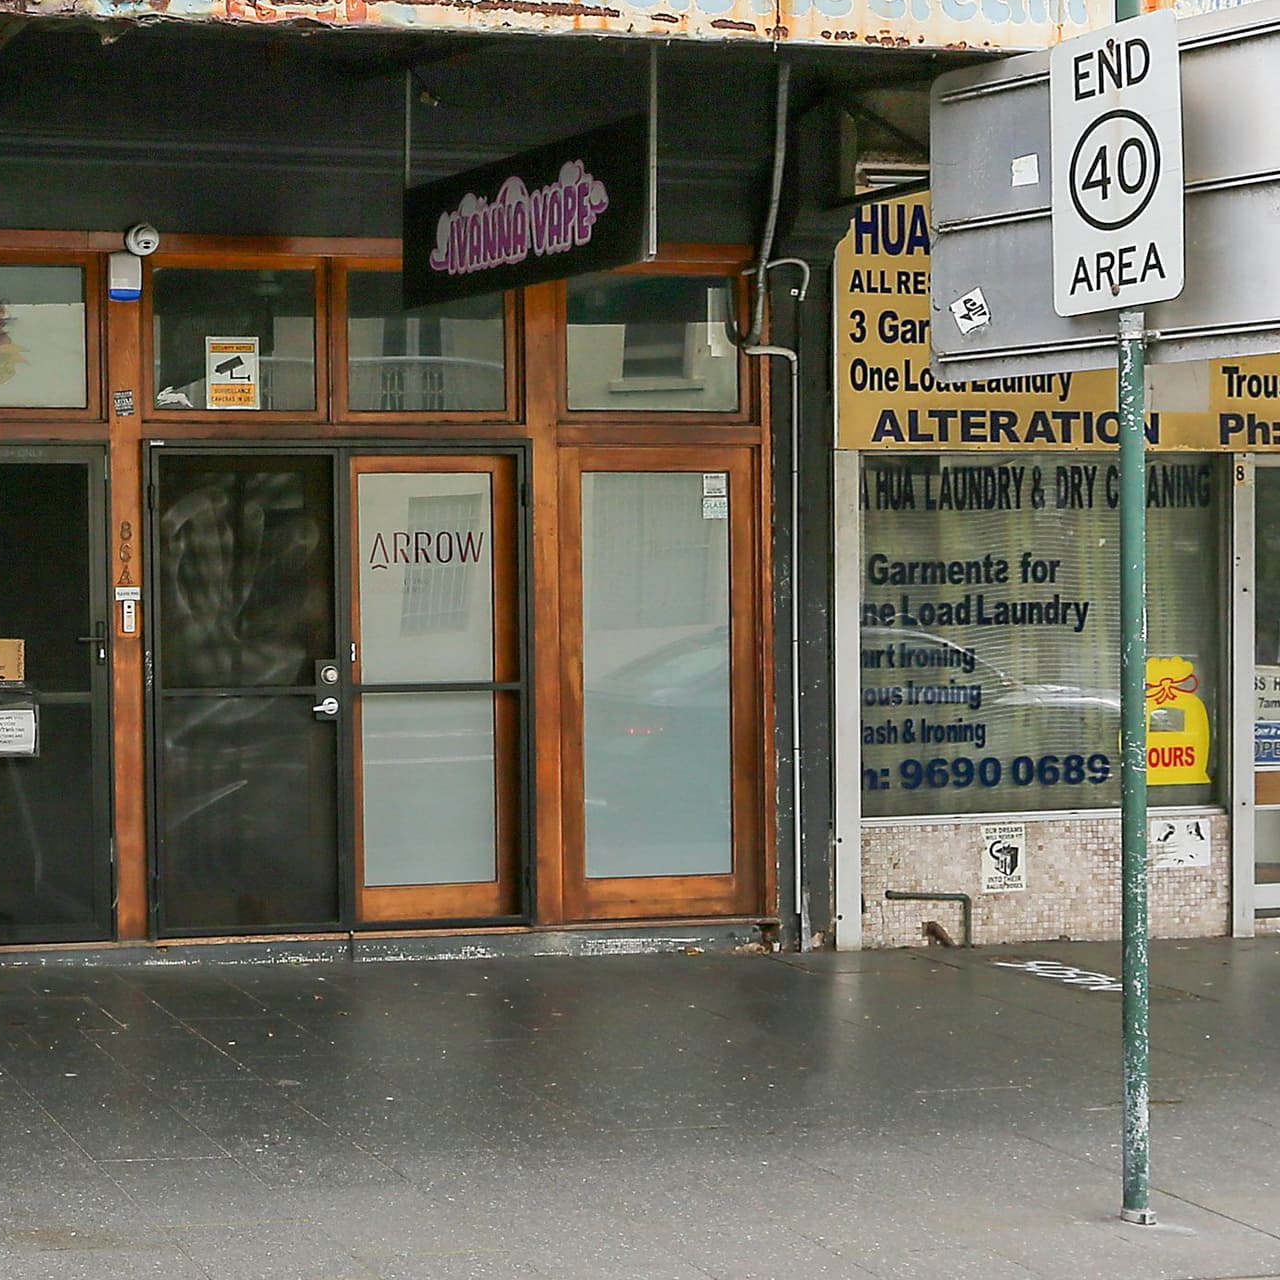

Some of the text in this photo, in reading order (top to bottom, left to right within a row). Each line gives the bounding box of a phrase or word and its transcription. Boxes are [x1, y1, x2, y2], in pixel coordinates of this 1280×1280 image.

[1074, 38, 1151, 102] END
[1081, 137, 1148, 200] 40
[530, 180, 594, 257] VAPE
[854, 203, 931, 256] HUA
[849, 269, 931, 296] ALL RE
[1069, 241, 1166, 296] AREA
[849, 309, 867, 344] 3
[850, 357, 899, 393] One
[872, 409, 1160, 445] ALTERATION
[875, 468, 916, 511] HUA
[925, 465, 1025, 511] LAUNDRY
[1031, 466, 1046, 510] &
[1055, 465, 1098, 509] DRY
[1105, 464, 1212, 510] CANING
[1235, 464, 1245, 482] 8
[369, 530, 484, 570] ARROW
[869, 551, 1061, 587] Garments for
[902, 594, 972, 627] Load
[977, 593, 1090, 633] Laundry
[900, 642, 976, 674] Ironing
[907, 679, 982, 710] Ironing
[1257, 697, 1280, 708] 7am
[902, 718, 917, 744] &
[920, 717, 987, 749] Ironing
[899, 756, 1002, 790] 9690
[1010, 753, 1112, 786] 0689
